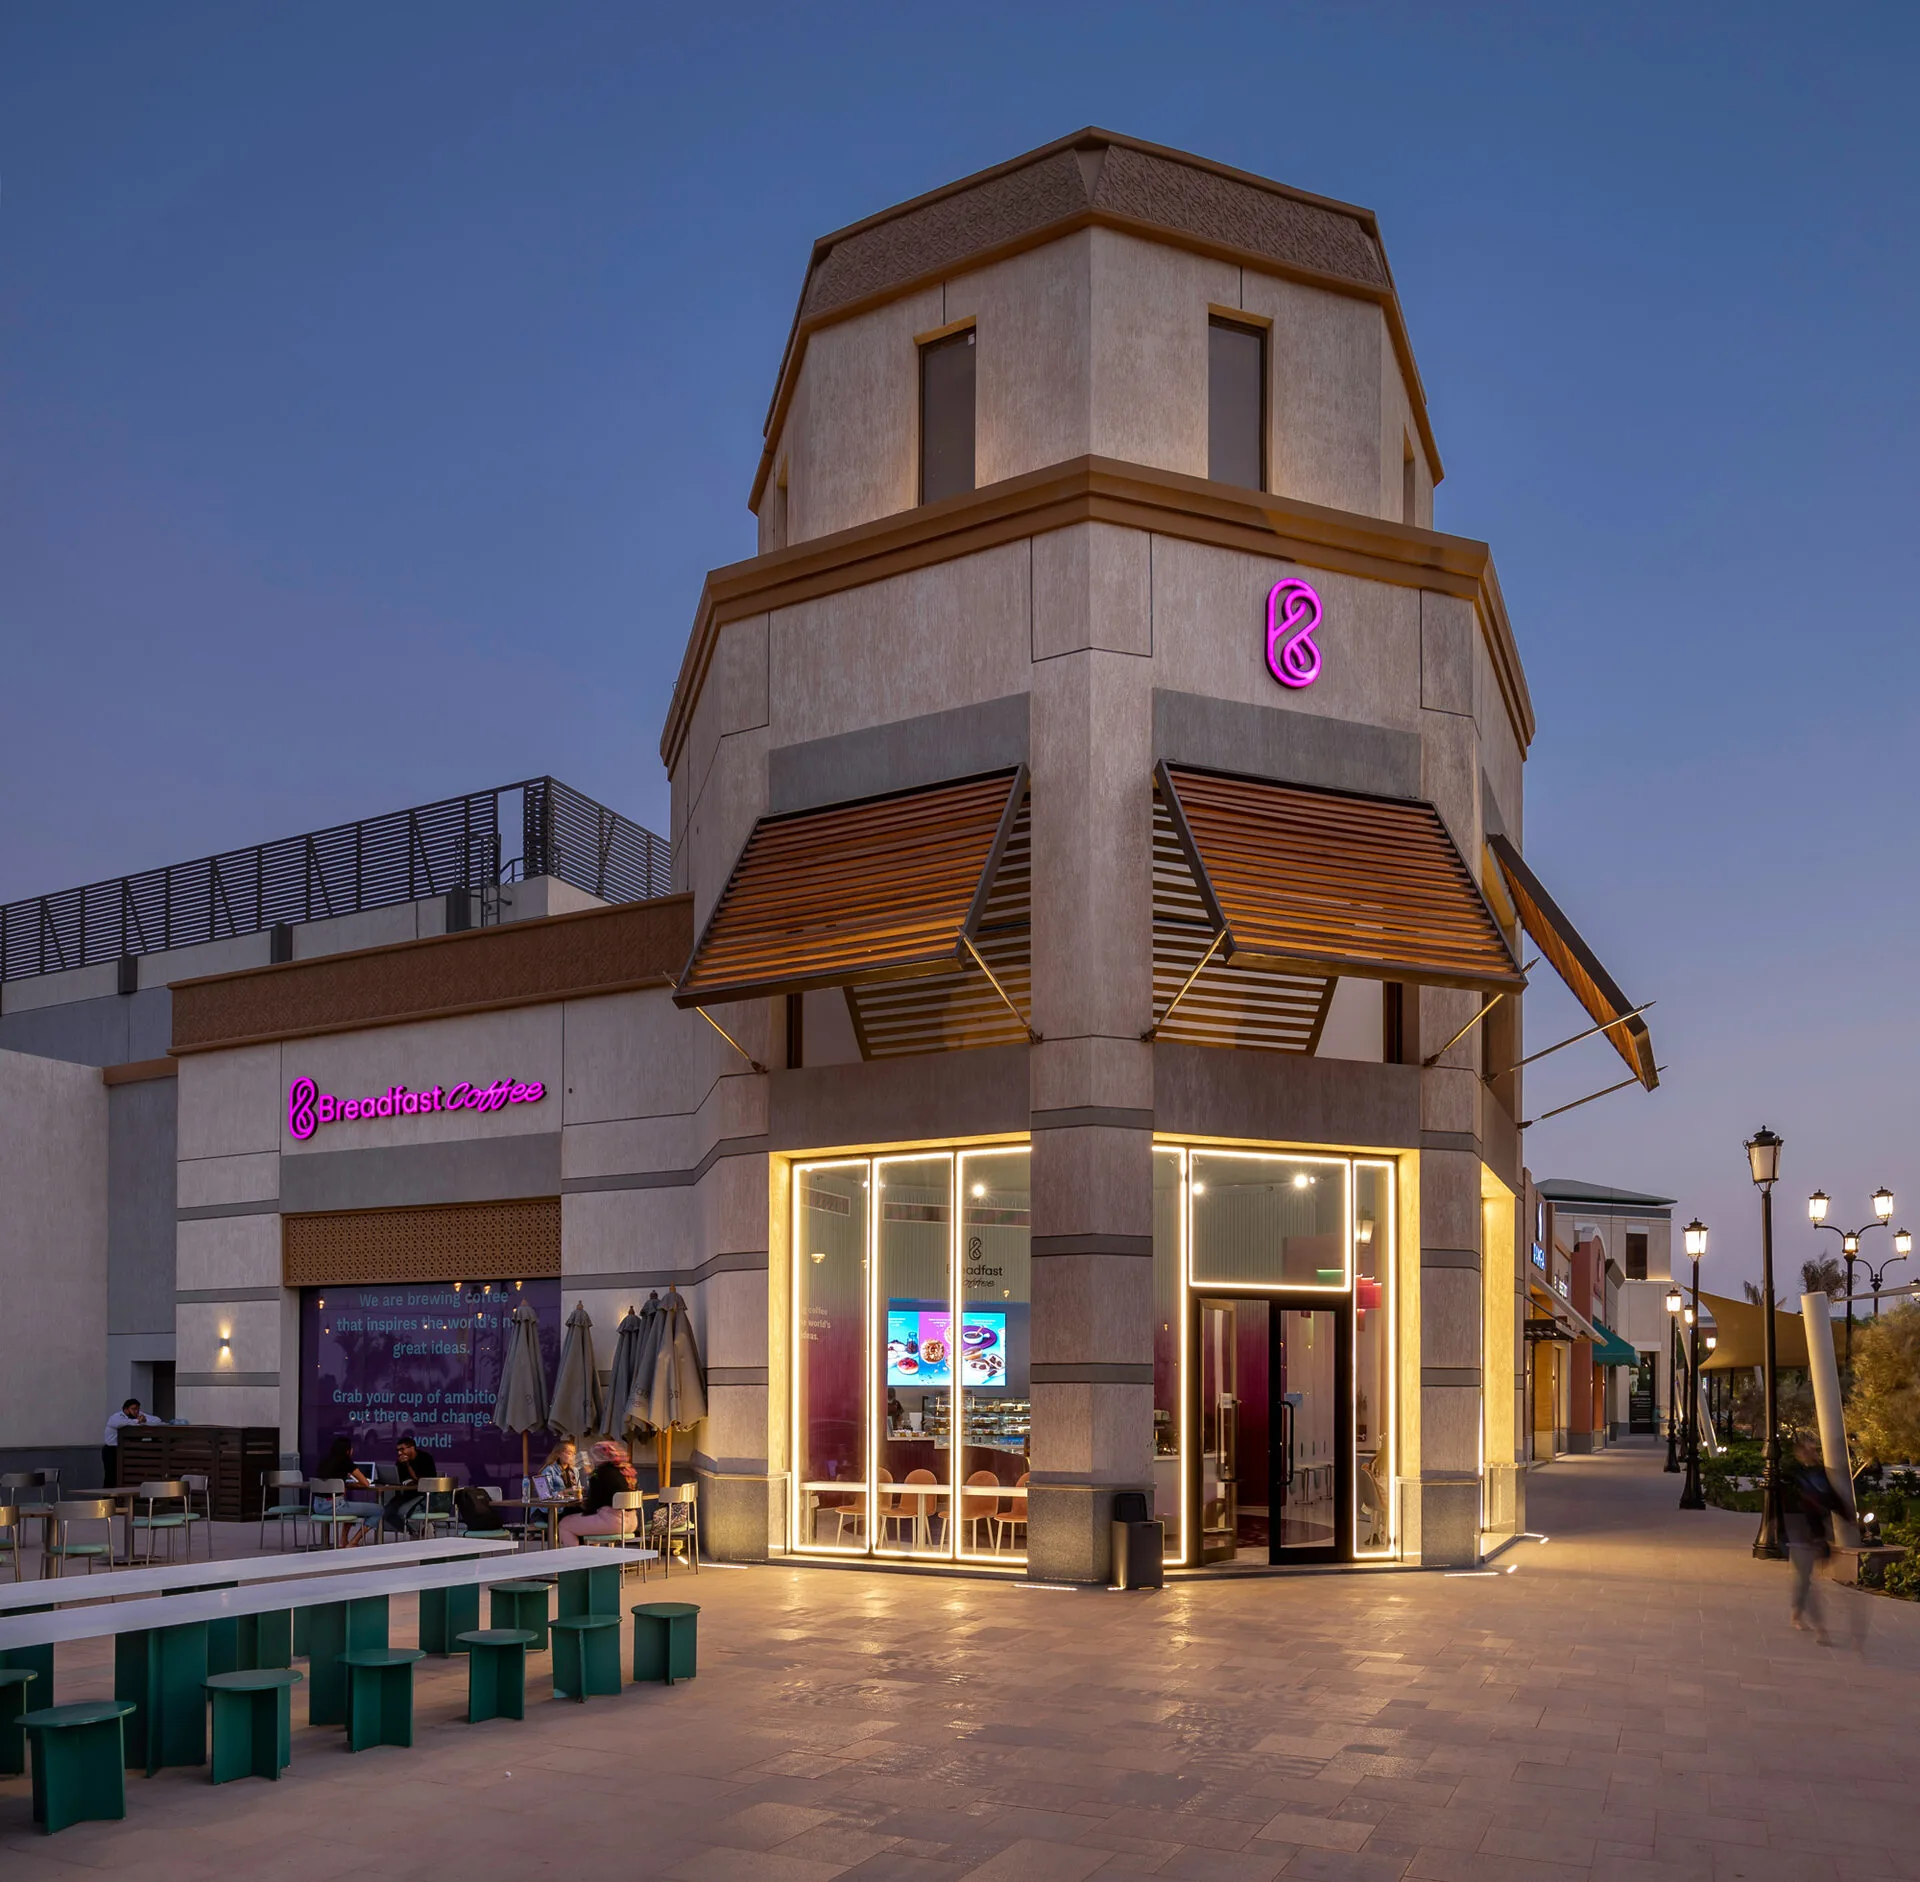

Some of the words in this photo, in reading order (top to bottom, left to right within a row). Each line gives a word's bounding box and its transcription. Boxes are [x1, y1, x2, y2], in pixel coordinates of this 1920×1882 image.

[317, 1085, 442, 1122] Breadfast
[446, 1078, 544, 1112] Coffee
[946, 1263, 1003, 1276] adfast
[962, 1278, 995, 1289] offee
[359, 1293, 378, 1307] We
[383, 1295, 403, 1306] are
[407, 1291, 460, 1308] brewing
[465, 1291, 509, 1305] coffee
[337, 1317, 363, 1332] that
[367, 1316, 418, 1335] inspires
[422, 1316, 444, 1330] the
[447, 1314, 498, 1329] world's
[393, 1342, 427, 1358] great
[431, 1340, 470, 1355] ideas.
[333, 1389, 363, 1403] Grab
[366, 1391, 395, 1406] your
[399, 1391, 423, 1407] cup
[427, 1389, 441, 1404] of
[444, 1389, 497, 1404] ambitio
[349, 1409, 370, 1422] out
[374, 1408, 409, 1422] there
[412, 1408, 437, 1423] and
